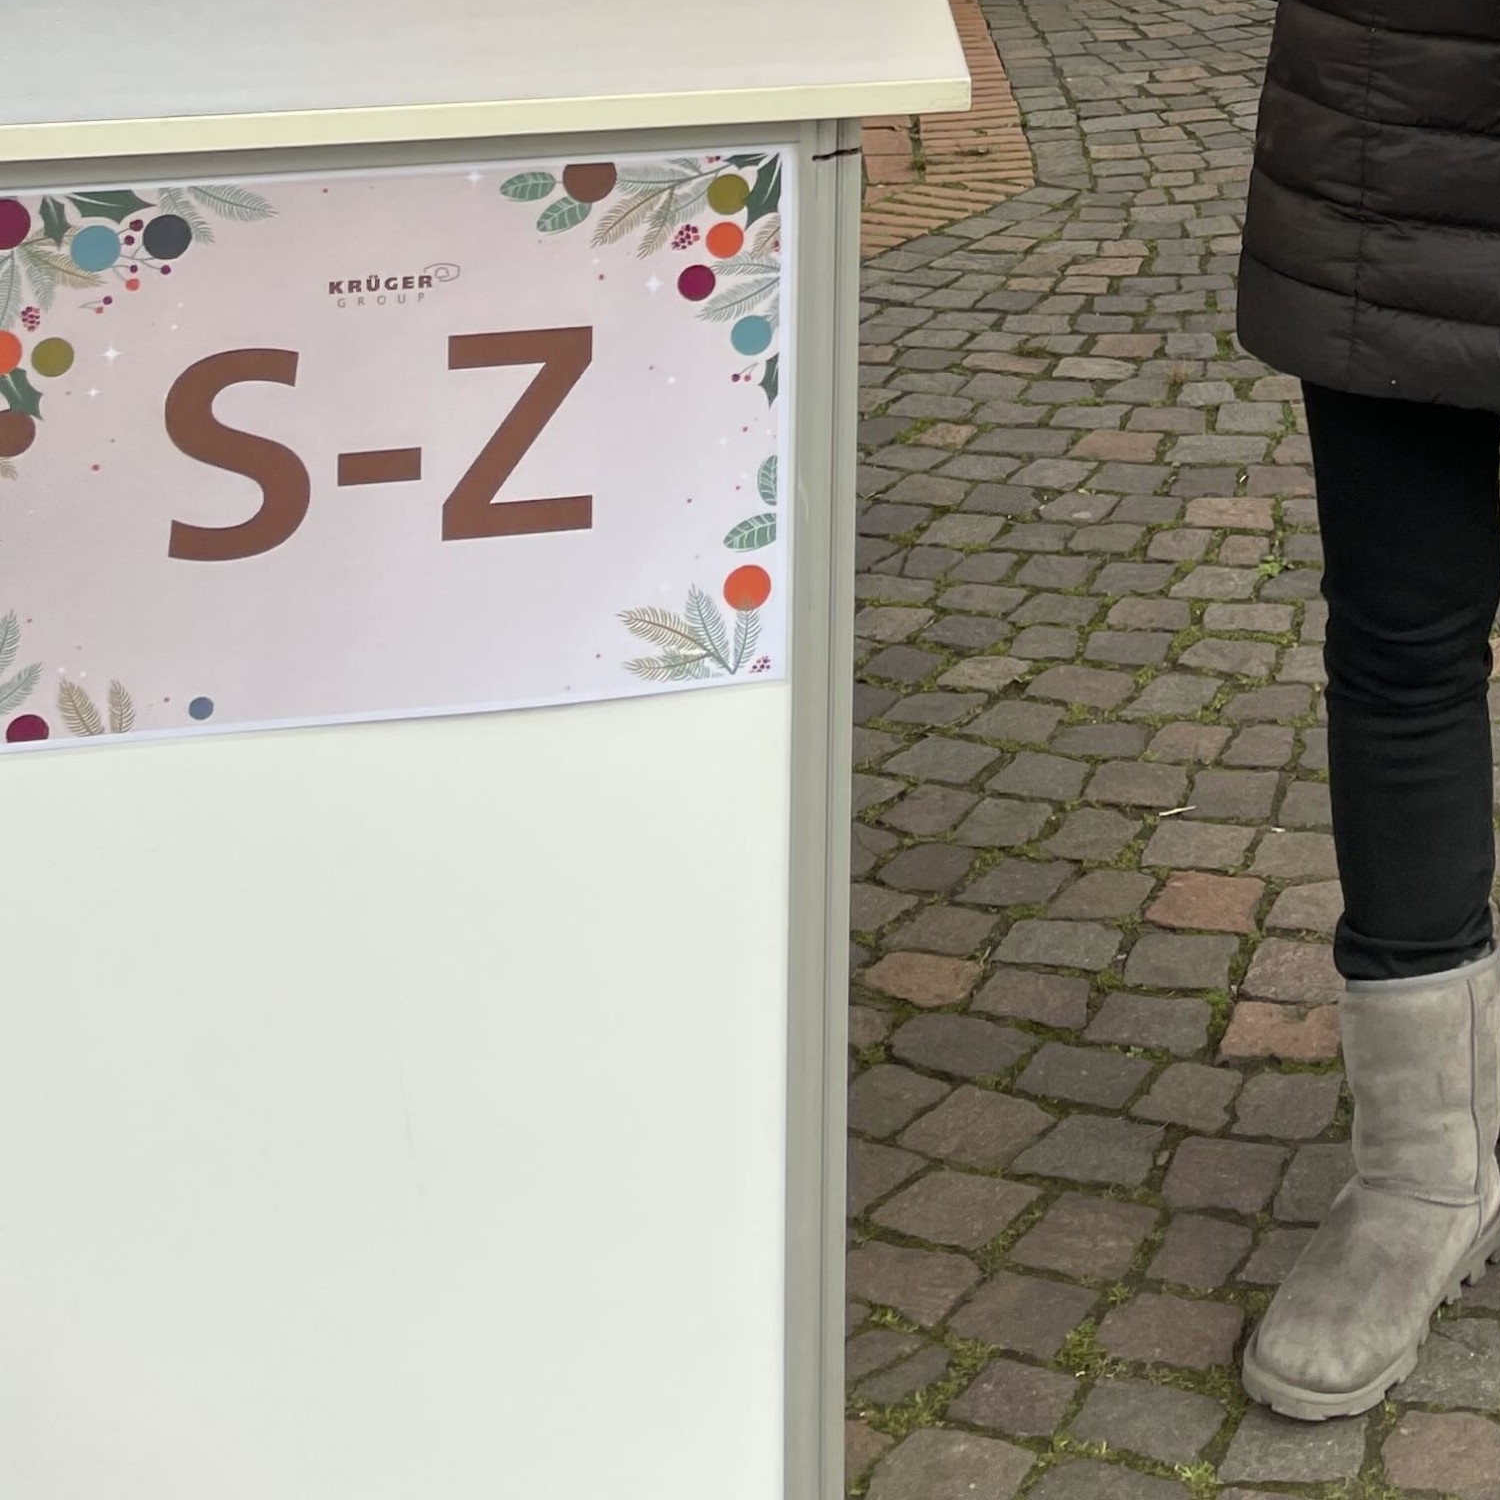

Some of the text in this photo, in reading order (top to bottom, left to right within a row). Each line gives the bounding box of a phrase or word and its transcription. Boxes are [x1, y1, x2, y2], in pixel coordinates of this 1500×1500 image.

[328, 275, 433, 295] KRÜGER
[337, 292, 425, 308] GROUP
[164, 325, 594, 562] S-Z
